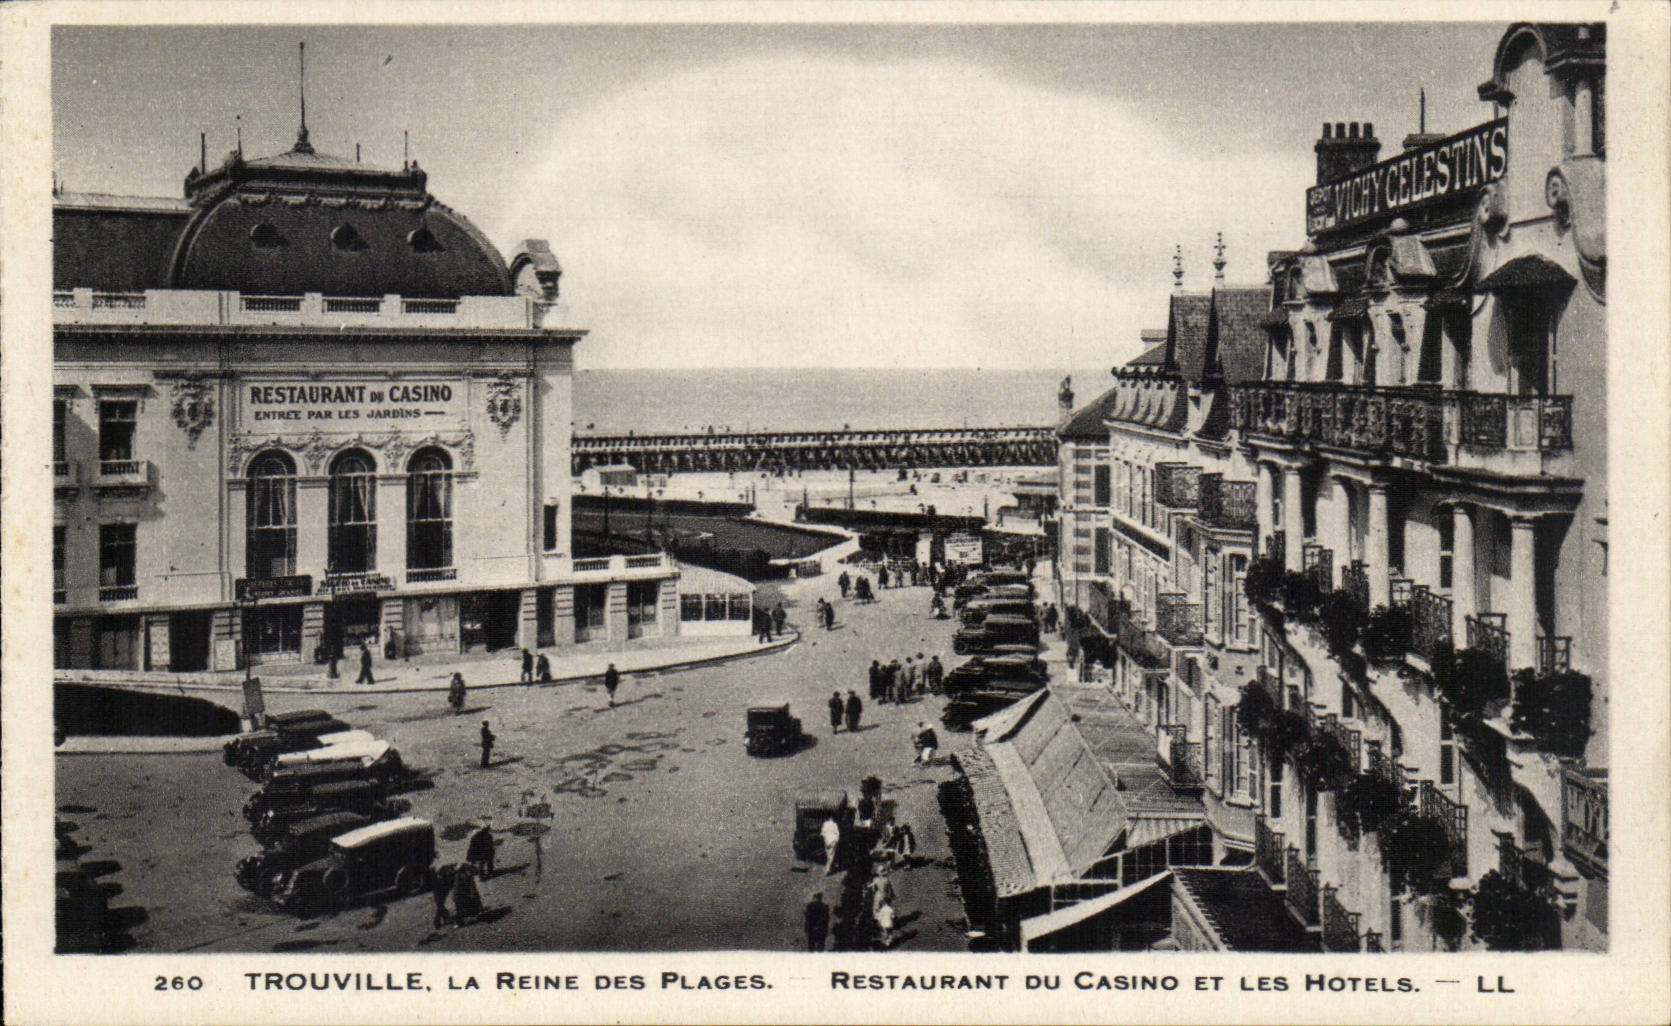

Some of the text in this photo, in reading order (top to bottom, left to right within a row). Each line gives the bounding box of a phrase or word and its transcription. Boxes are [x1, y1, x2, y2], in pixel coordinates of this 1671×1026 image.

[1335, 126, 1506, 221] VICHY CELESTINS
[250, 384, 452, 404] RESTAURANT DU CASINO
[307, 410, 334, 420] PAR
[338, 409, 360, 420] LES
[366, 407, 421, 420] JARDINS
